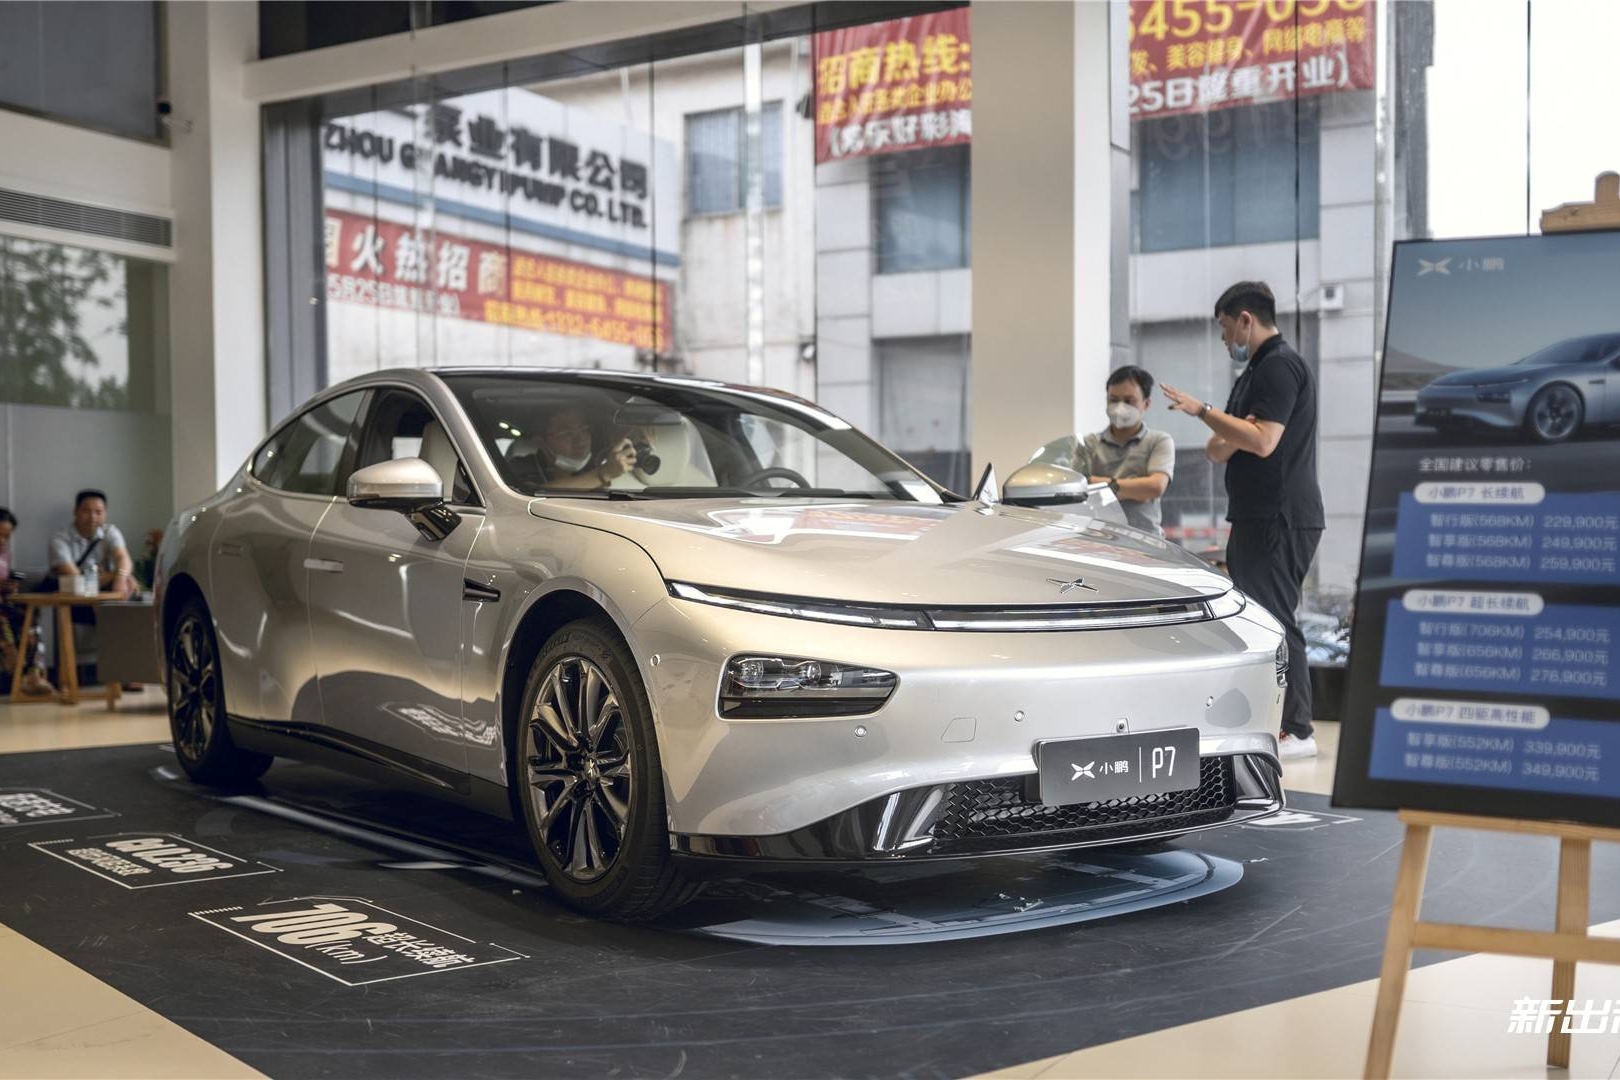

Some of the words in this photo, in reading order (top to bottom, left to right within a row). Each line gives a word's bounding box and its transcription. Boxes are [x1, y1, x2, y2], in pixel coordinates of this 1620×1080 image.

[1418, 456, 1533, 473] 全国建议零售价:
[1099, 759, 1129, 775] 小鹏
[1152, 746, 1176, 779] P7
[230, 903, 398, 945] 706
[362, 931, 475, 968] 超长续航
[304, 940, 388, 965] (km)
